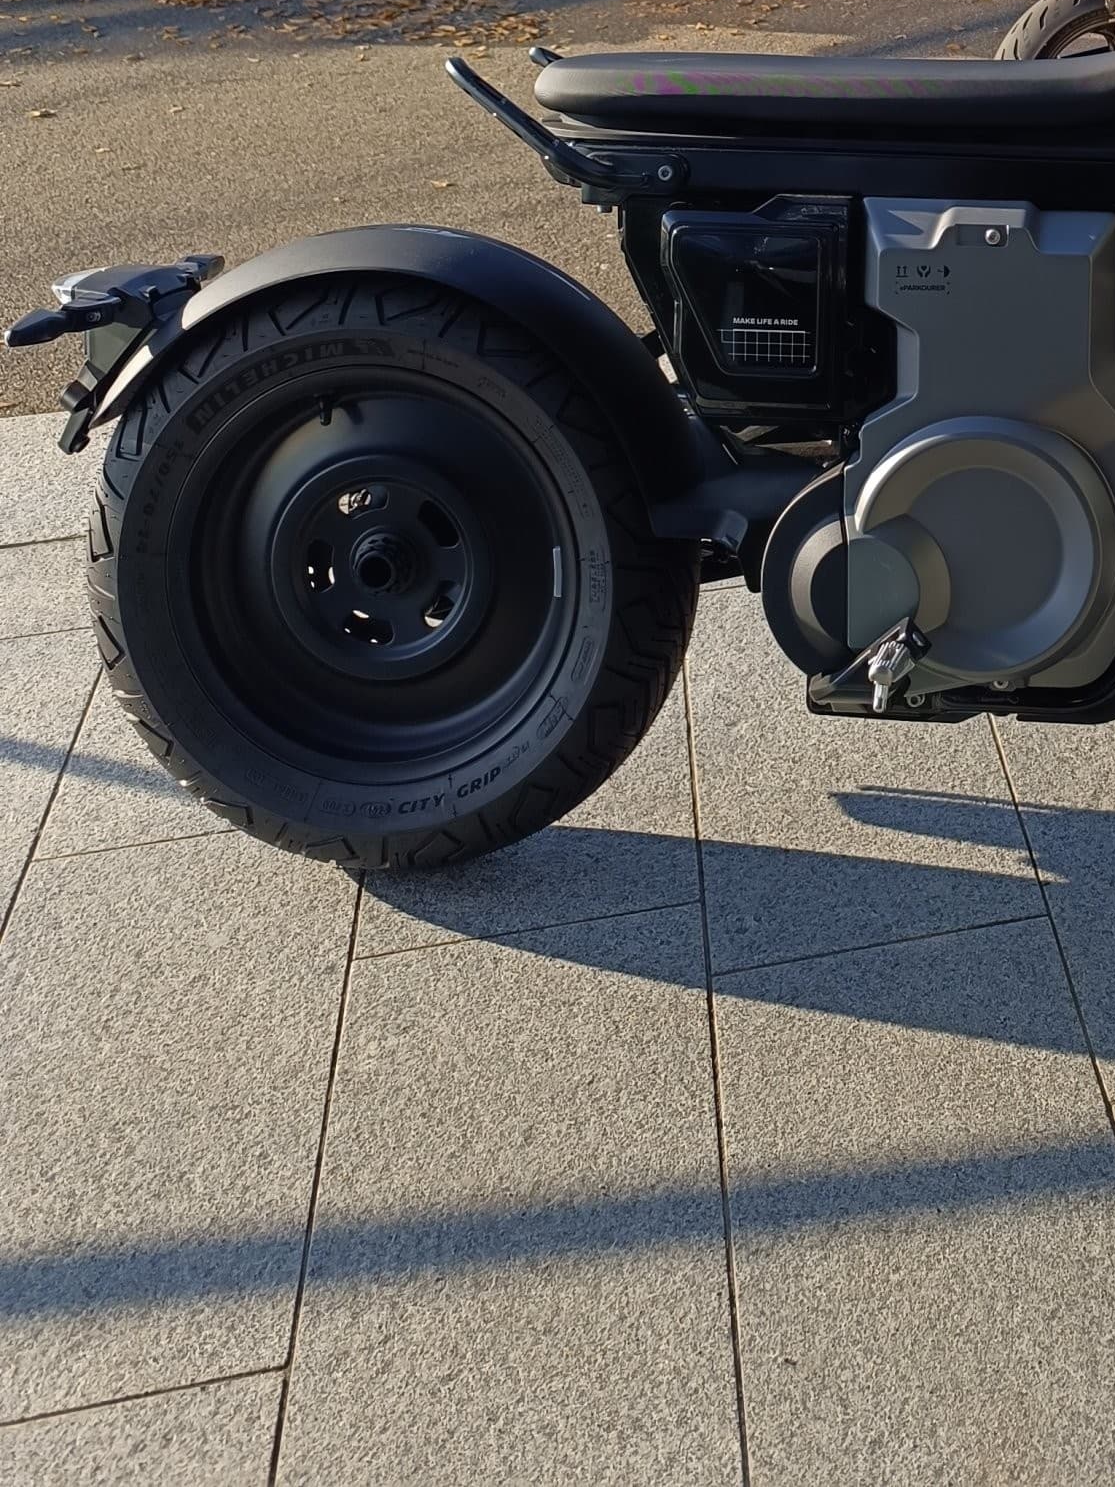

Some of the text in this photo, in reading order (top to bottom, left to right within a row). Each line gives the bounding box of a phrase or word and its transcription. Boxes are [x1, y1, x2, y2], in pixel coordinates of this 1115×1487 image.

[733, 317, 755, 325] MAKE
[195, 342, 343, 425] MICHELIN
[398, 767, 501, 814] CITY GRIP
